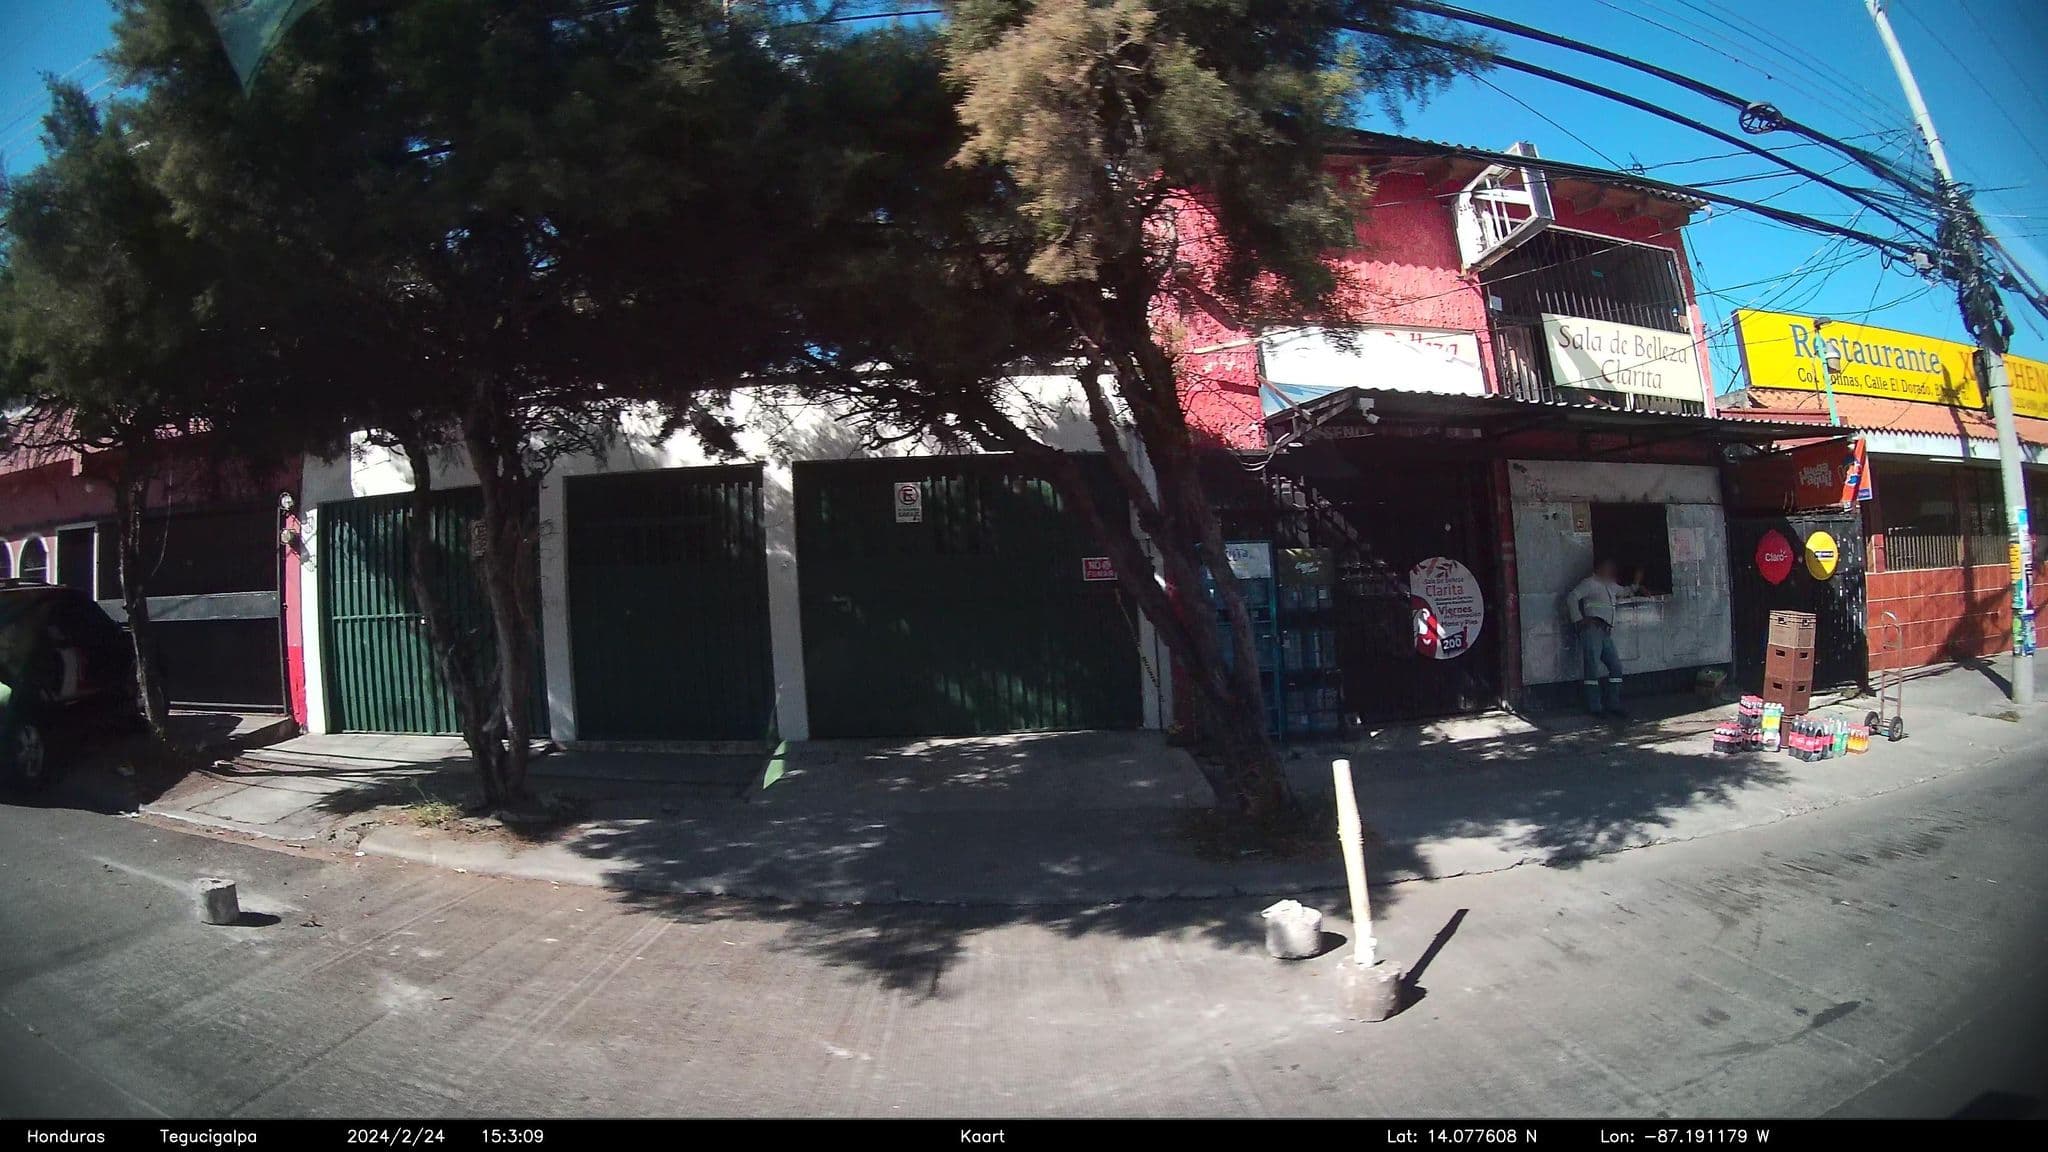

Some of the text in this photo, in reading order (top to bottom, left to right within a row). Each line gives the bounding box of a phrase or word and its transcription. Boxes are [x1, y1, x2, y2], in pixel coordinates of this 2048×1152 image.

[1559, 325, 1688, 364] Sala de Belleza
[1789, 324, 1942, 374] Restaurante
[1601, 359, 1663, 389] Clarita
[1864, 374, 1888, 390] Calle
[1890, 378, 1900, 392] El
[1765, 552, 1785, 562] Claro
[1426, 584, 1464, 596] Clarita
[1438, 606, 1472, 615] Viernes
[1443, 639, 1462, 650] 200
